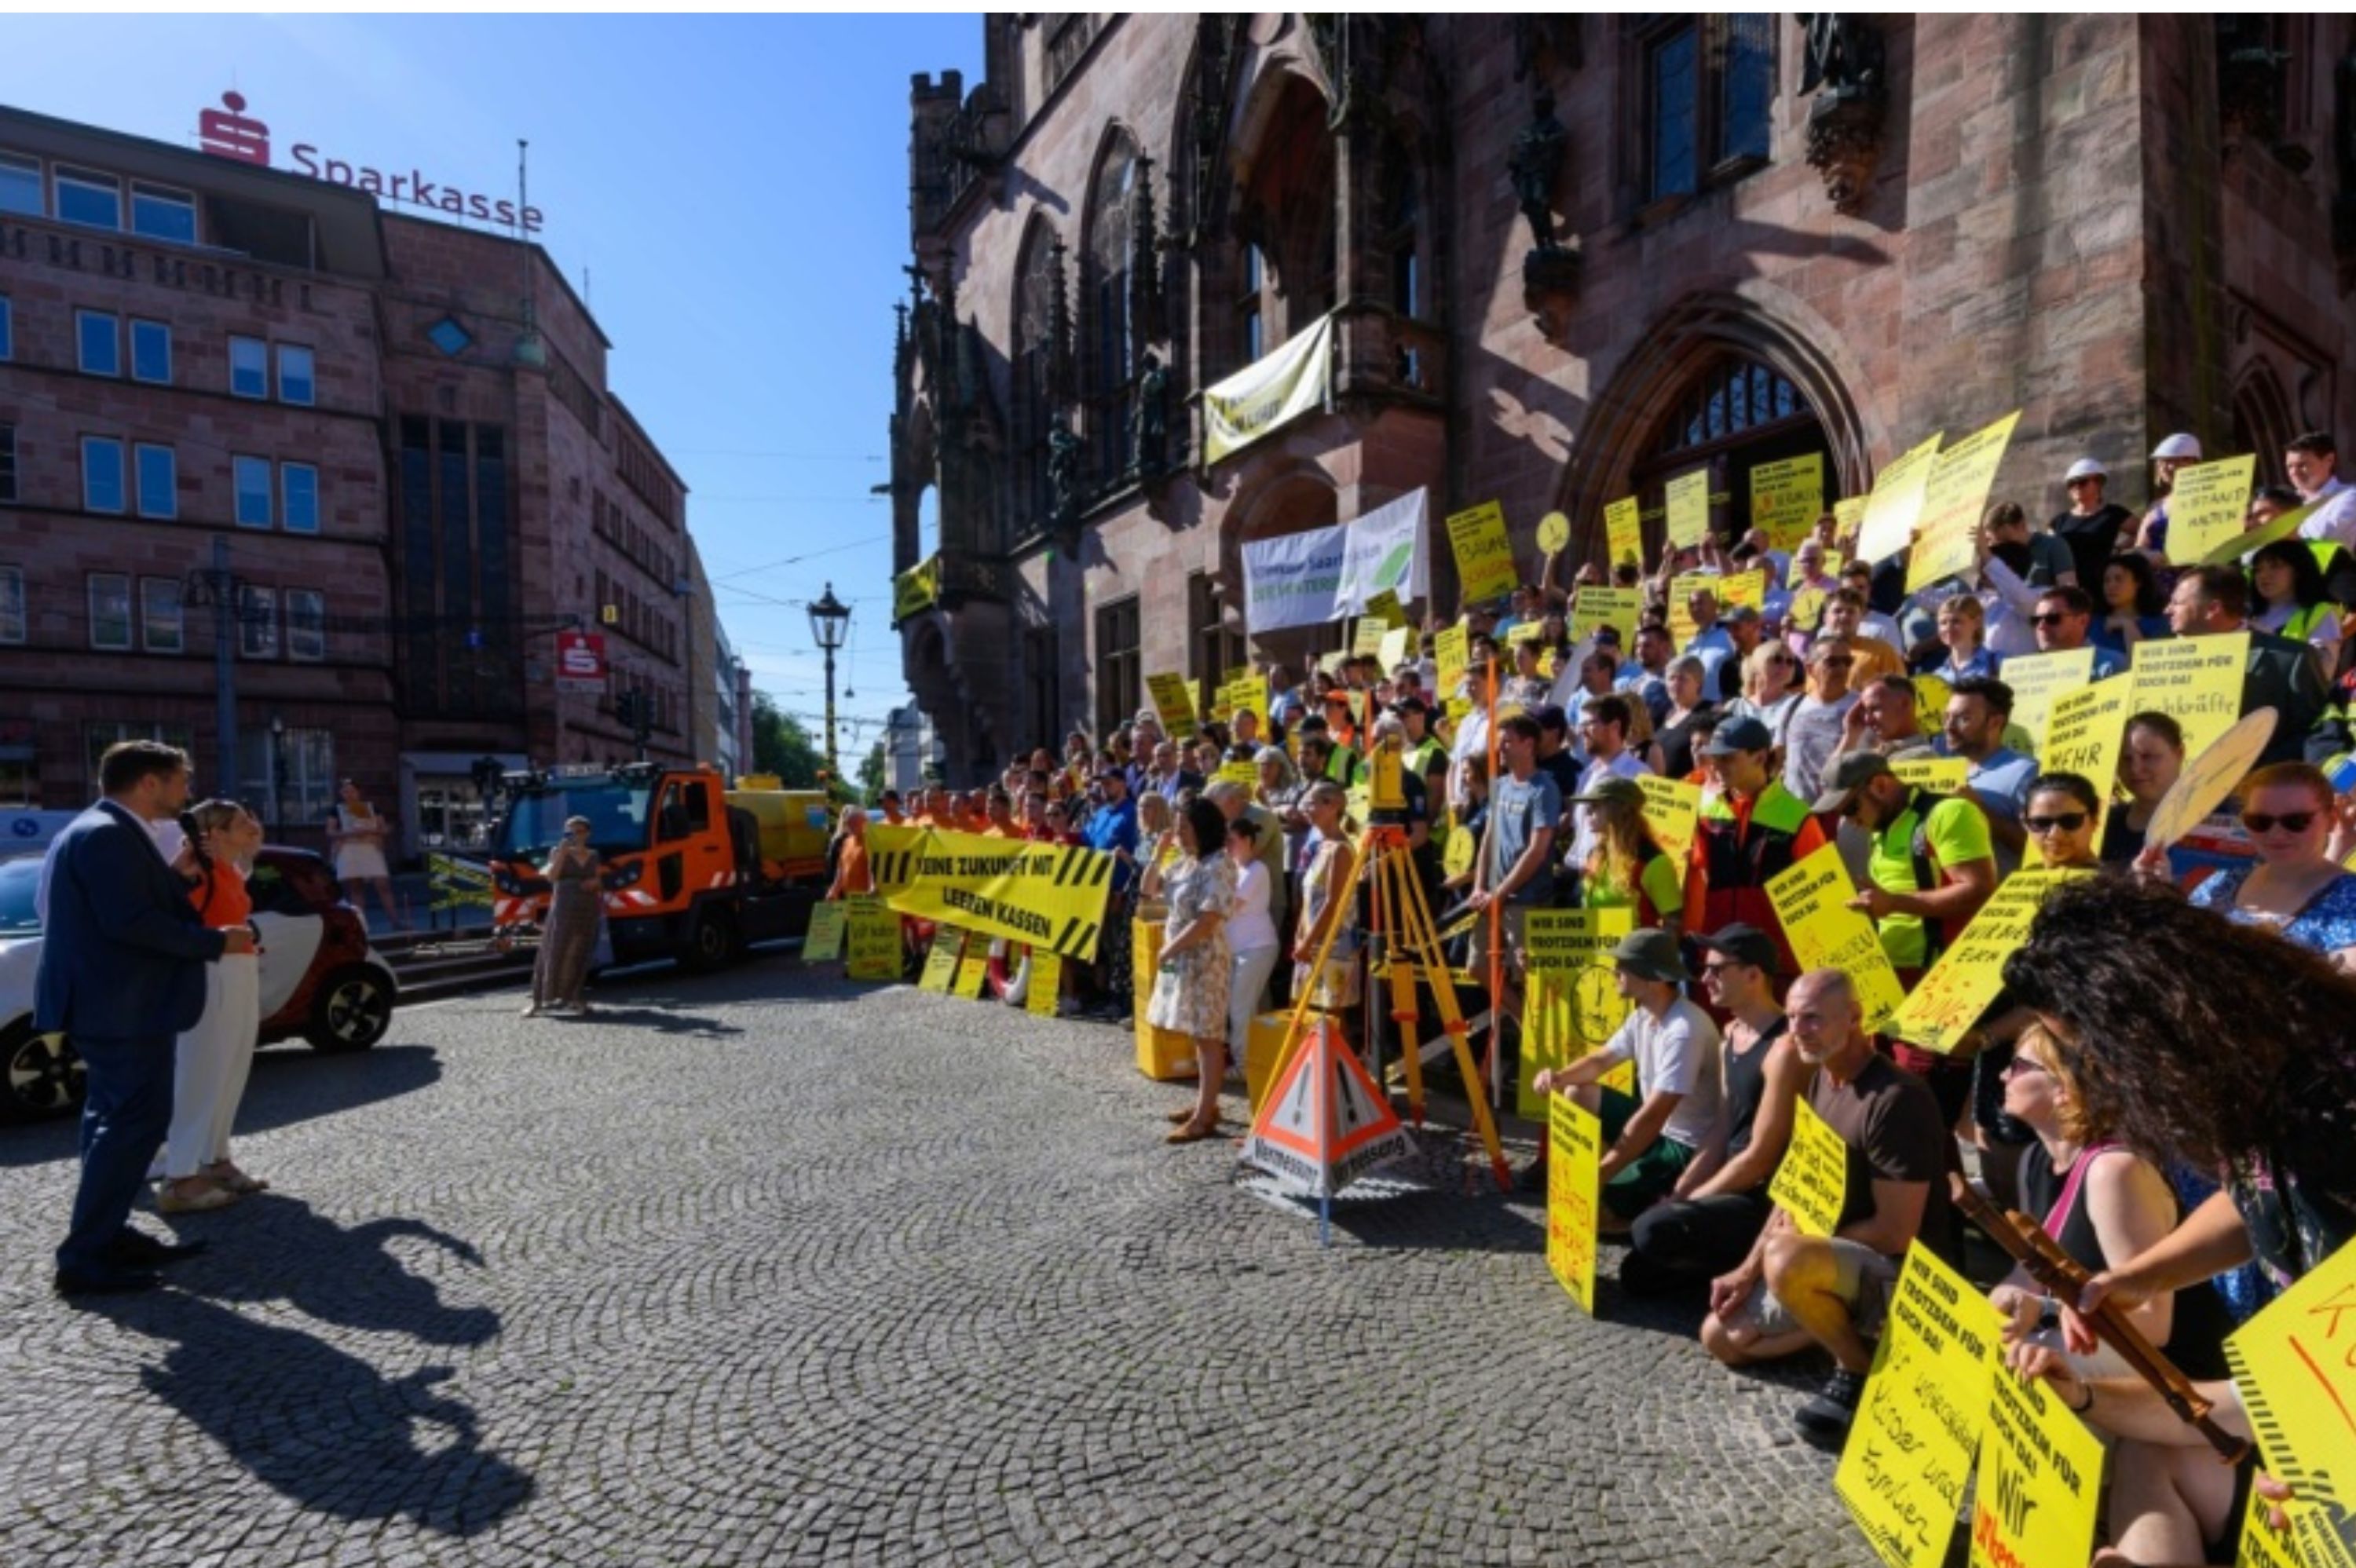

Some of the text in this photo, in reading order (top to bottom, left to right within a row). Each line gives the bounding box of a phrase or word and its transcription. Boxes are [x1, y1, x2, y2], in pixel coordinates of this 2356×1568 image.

[291, 143, 543, 232] Sparkasse
[997, 903, 1052, 940] KASSEN
[1531, 916, 1585, 930] WIR SIND
[1531, 935, 1594, 949] TROTZDEM
[1912, 1254, 1959, 1307] WIR SIND
[1895, 1299, 1923, 1336] EUCH
[1904, 1277, 1987, 1364] TROTZDEM FÜR
[1988, 1398, 2015, 1449] EUCH
[1992, 1370, 2052, 1462] TROTZDEM
[2052, 1449, 2081, 1500] FÜR
[1996, 1445, 2038, 1538] Wir
